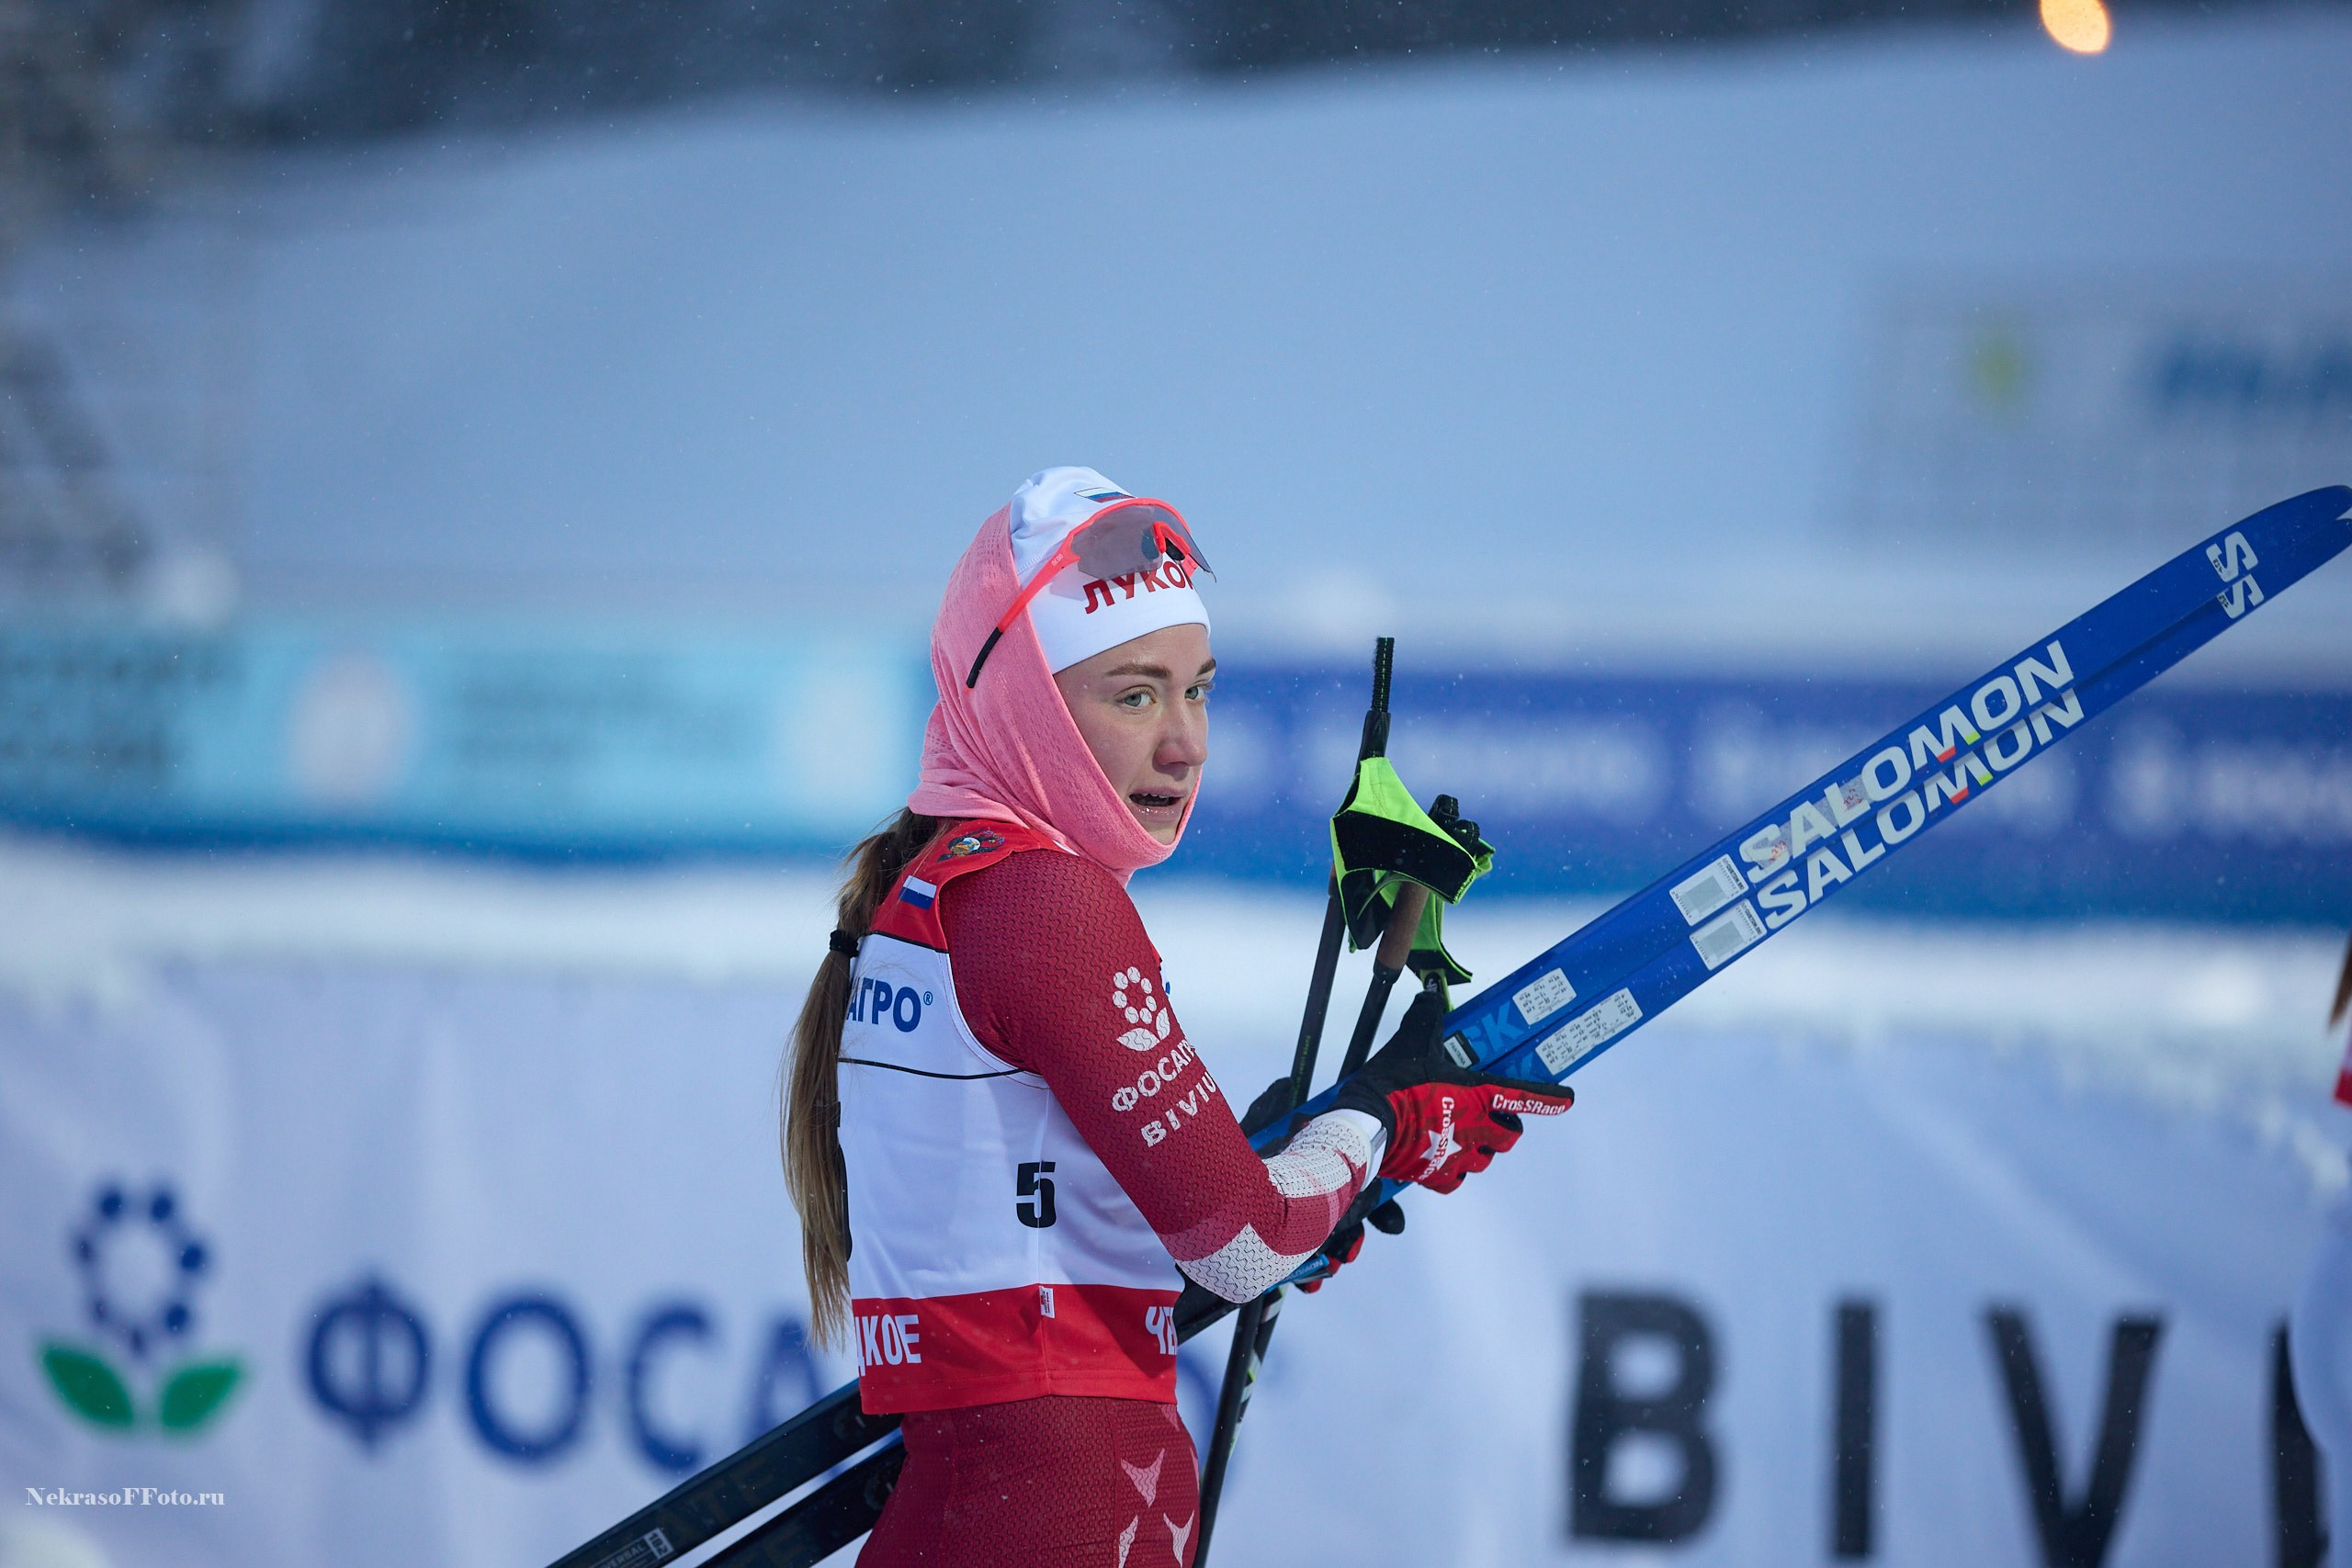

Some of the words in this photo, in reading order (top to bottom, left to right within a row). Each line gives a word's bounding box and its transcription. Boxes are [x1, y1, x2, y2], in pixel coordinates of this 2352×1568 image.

[1739, 640, 2075, 884] SALOMON
[1757, 686, 2085, 931] SALOMON
[1015, 1161, 1057, 1229] 5
